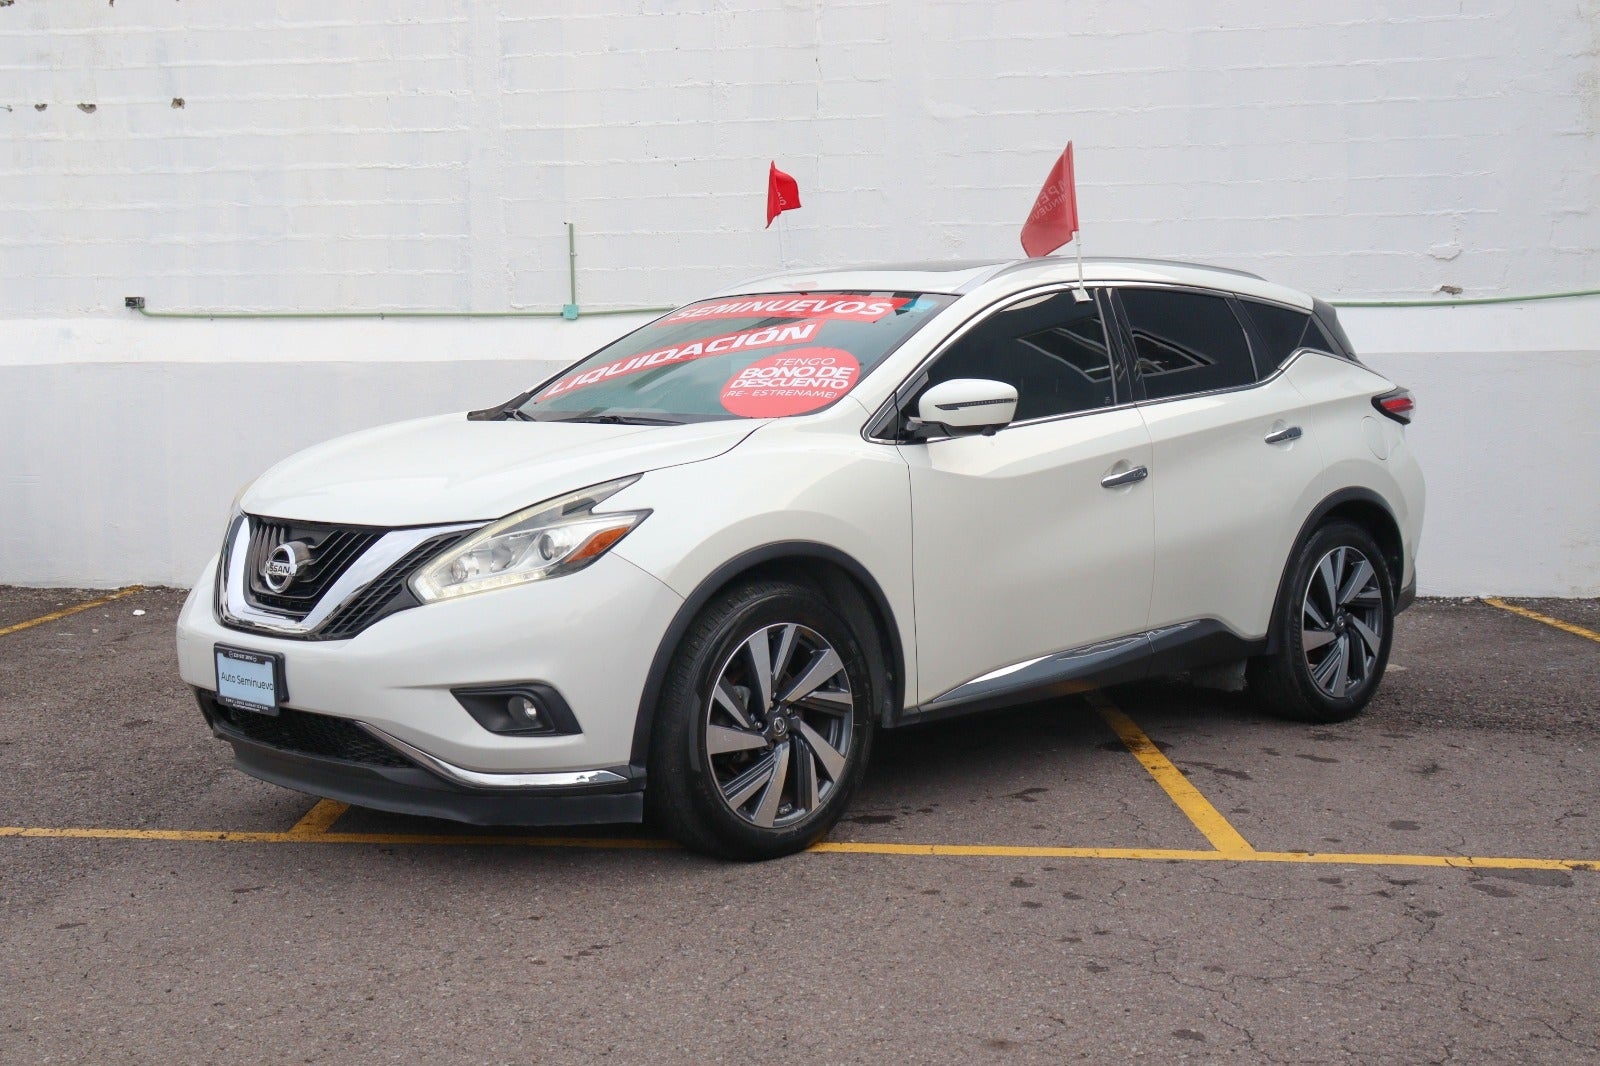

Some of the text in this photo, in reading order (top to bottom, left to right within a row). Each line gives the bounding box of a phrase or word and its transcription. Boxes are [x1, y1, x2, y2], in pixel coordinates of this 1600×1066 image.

[668, 299, 893, 322] SEMINUEVOS
[547, 324, 815, 397] LIQUIDACIÓN
[774, 357, 836, 366] TENGO
[739, 366, 855, 379] BONO DE
[729, 378, 849, 390] DESCUENTO
[265, 561, 291, 574] ISSAN
[220, 671, 274, 691] Auto Seminuevo
